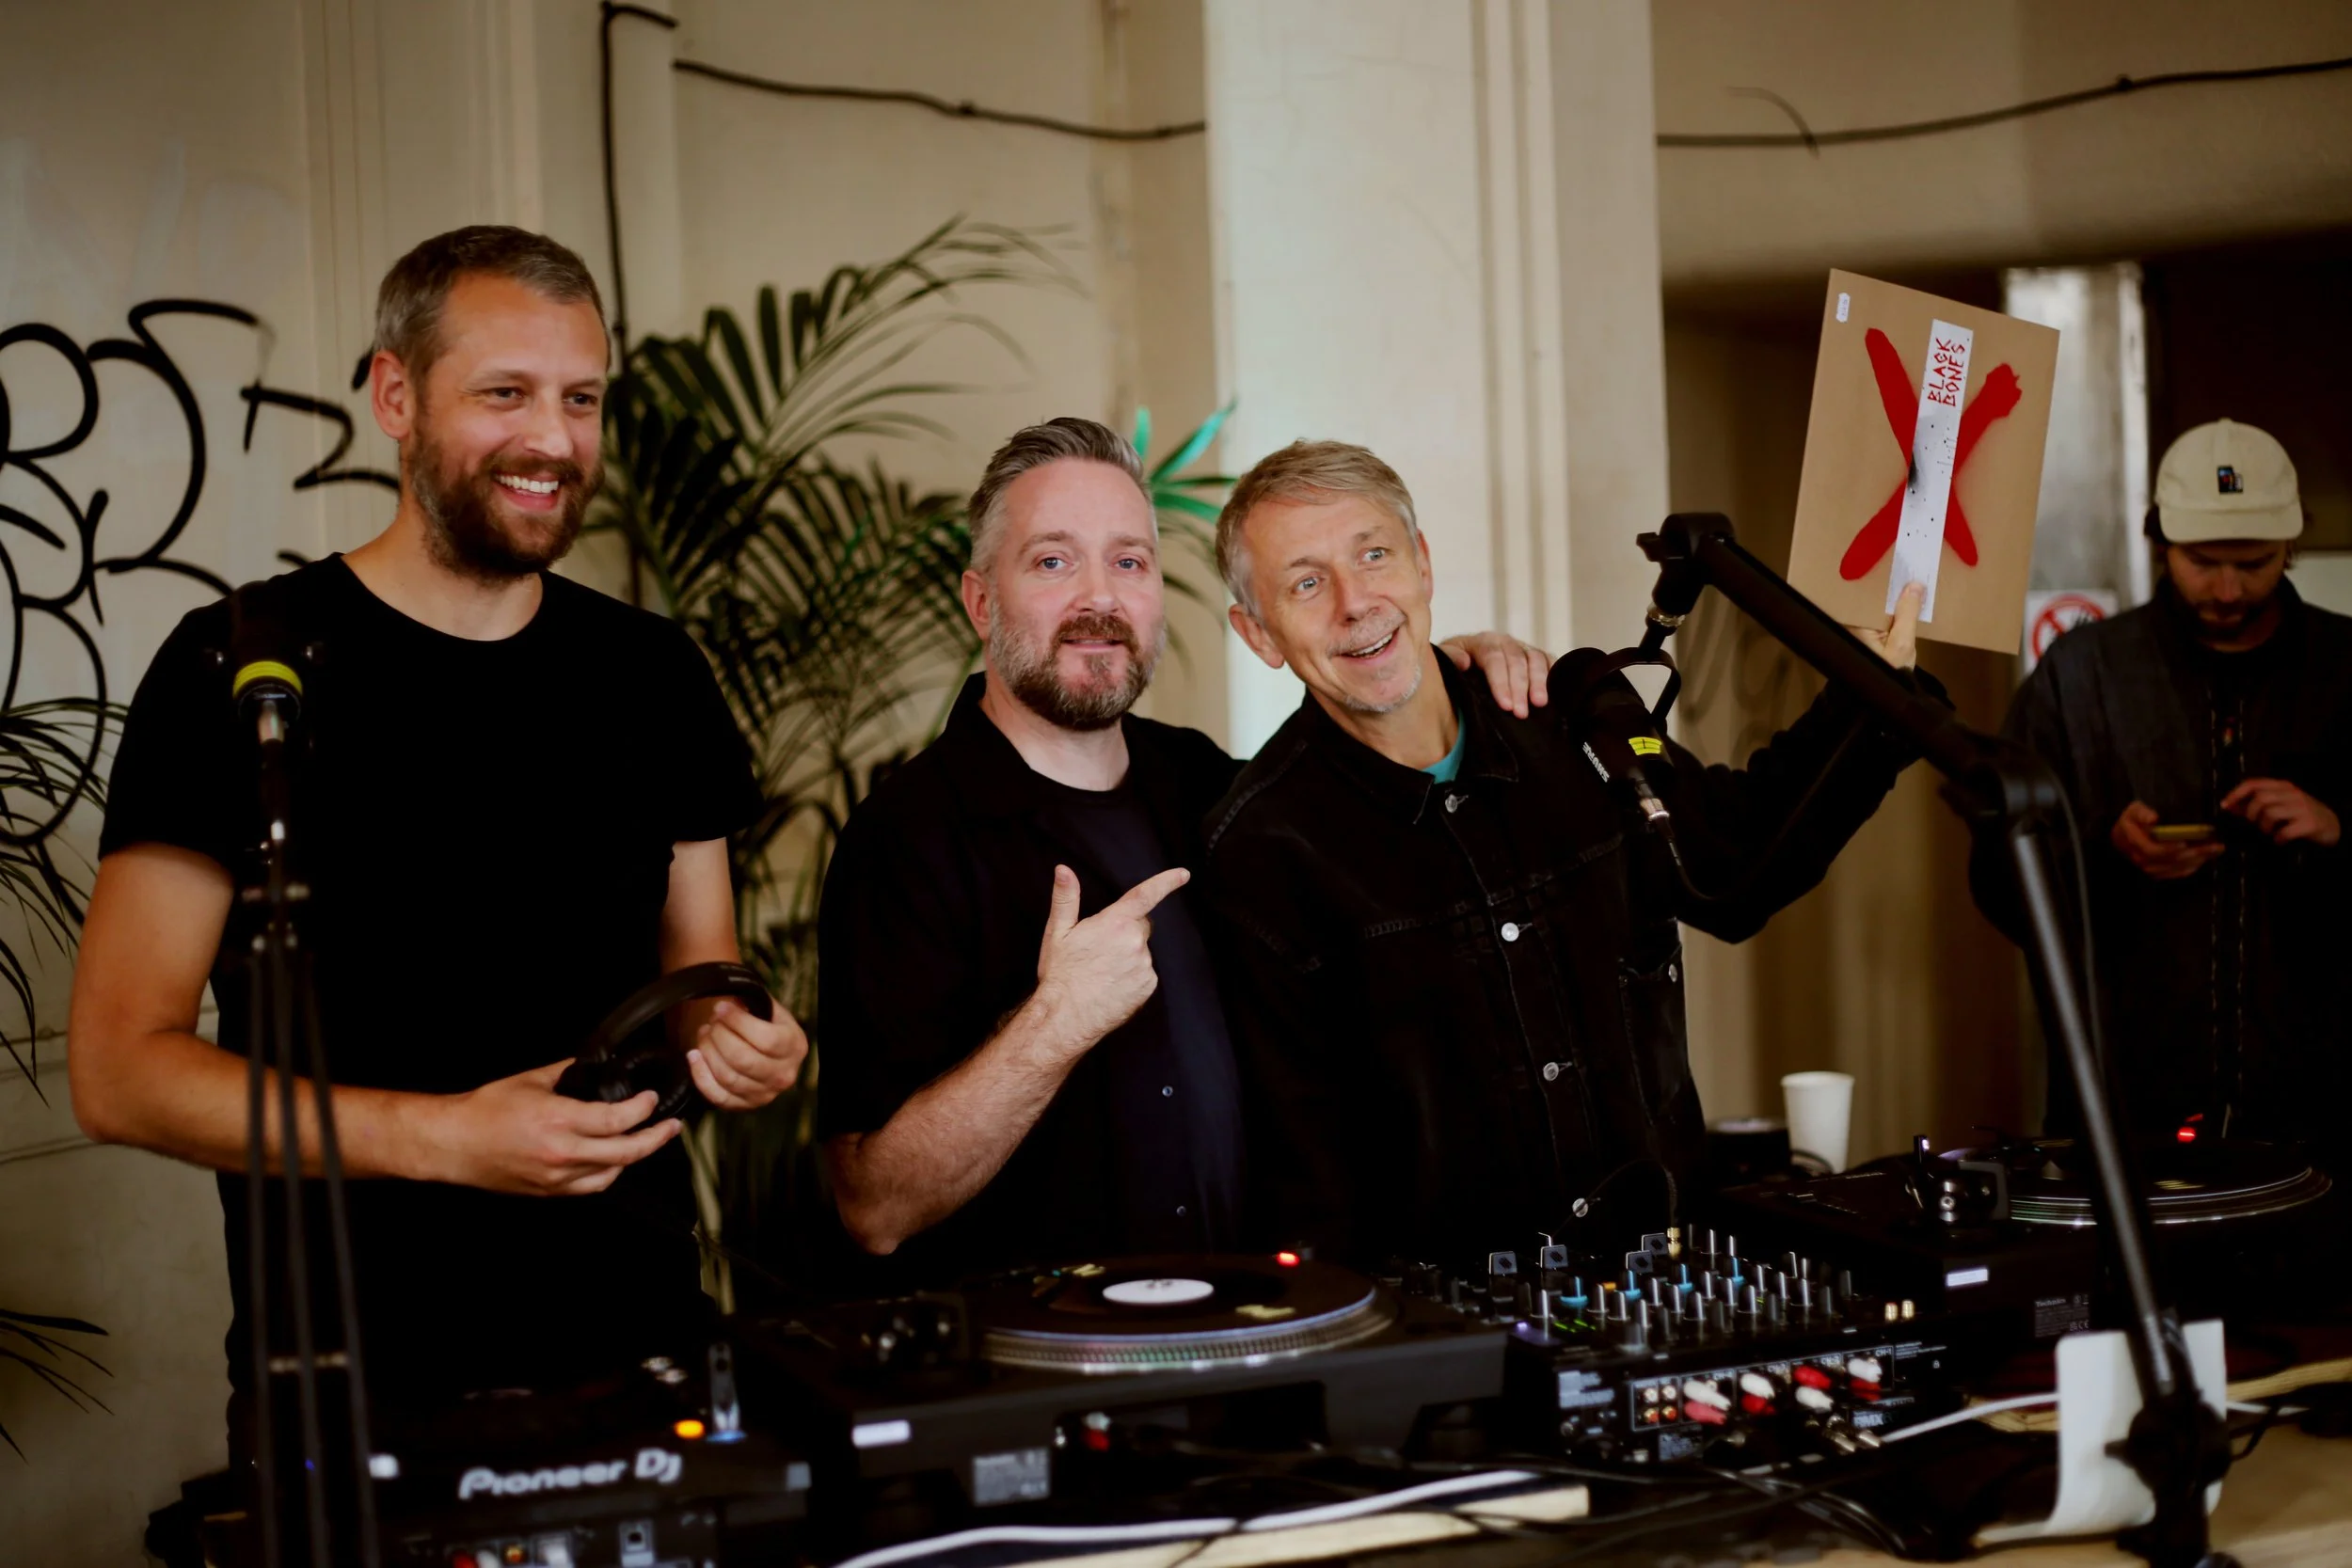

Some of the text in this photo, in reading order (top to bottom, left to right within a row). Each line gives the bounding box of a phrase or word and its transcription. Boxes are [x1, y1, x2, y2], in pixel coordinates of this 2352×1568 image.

[1927, 337, 1952, 404] BLACK
[1942, 343, 1965, 406] BONES
[1581, 740, 1611, 784] SHURE
[458, 1460, 628, 1499] Pioneer
